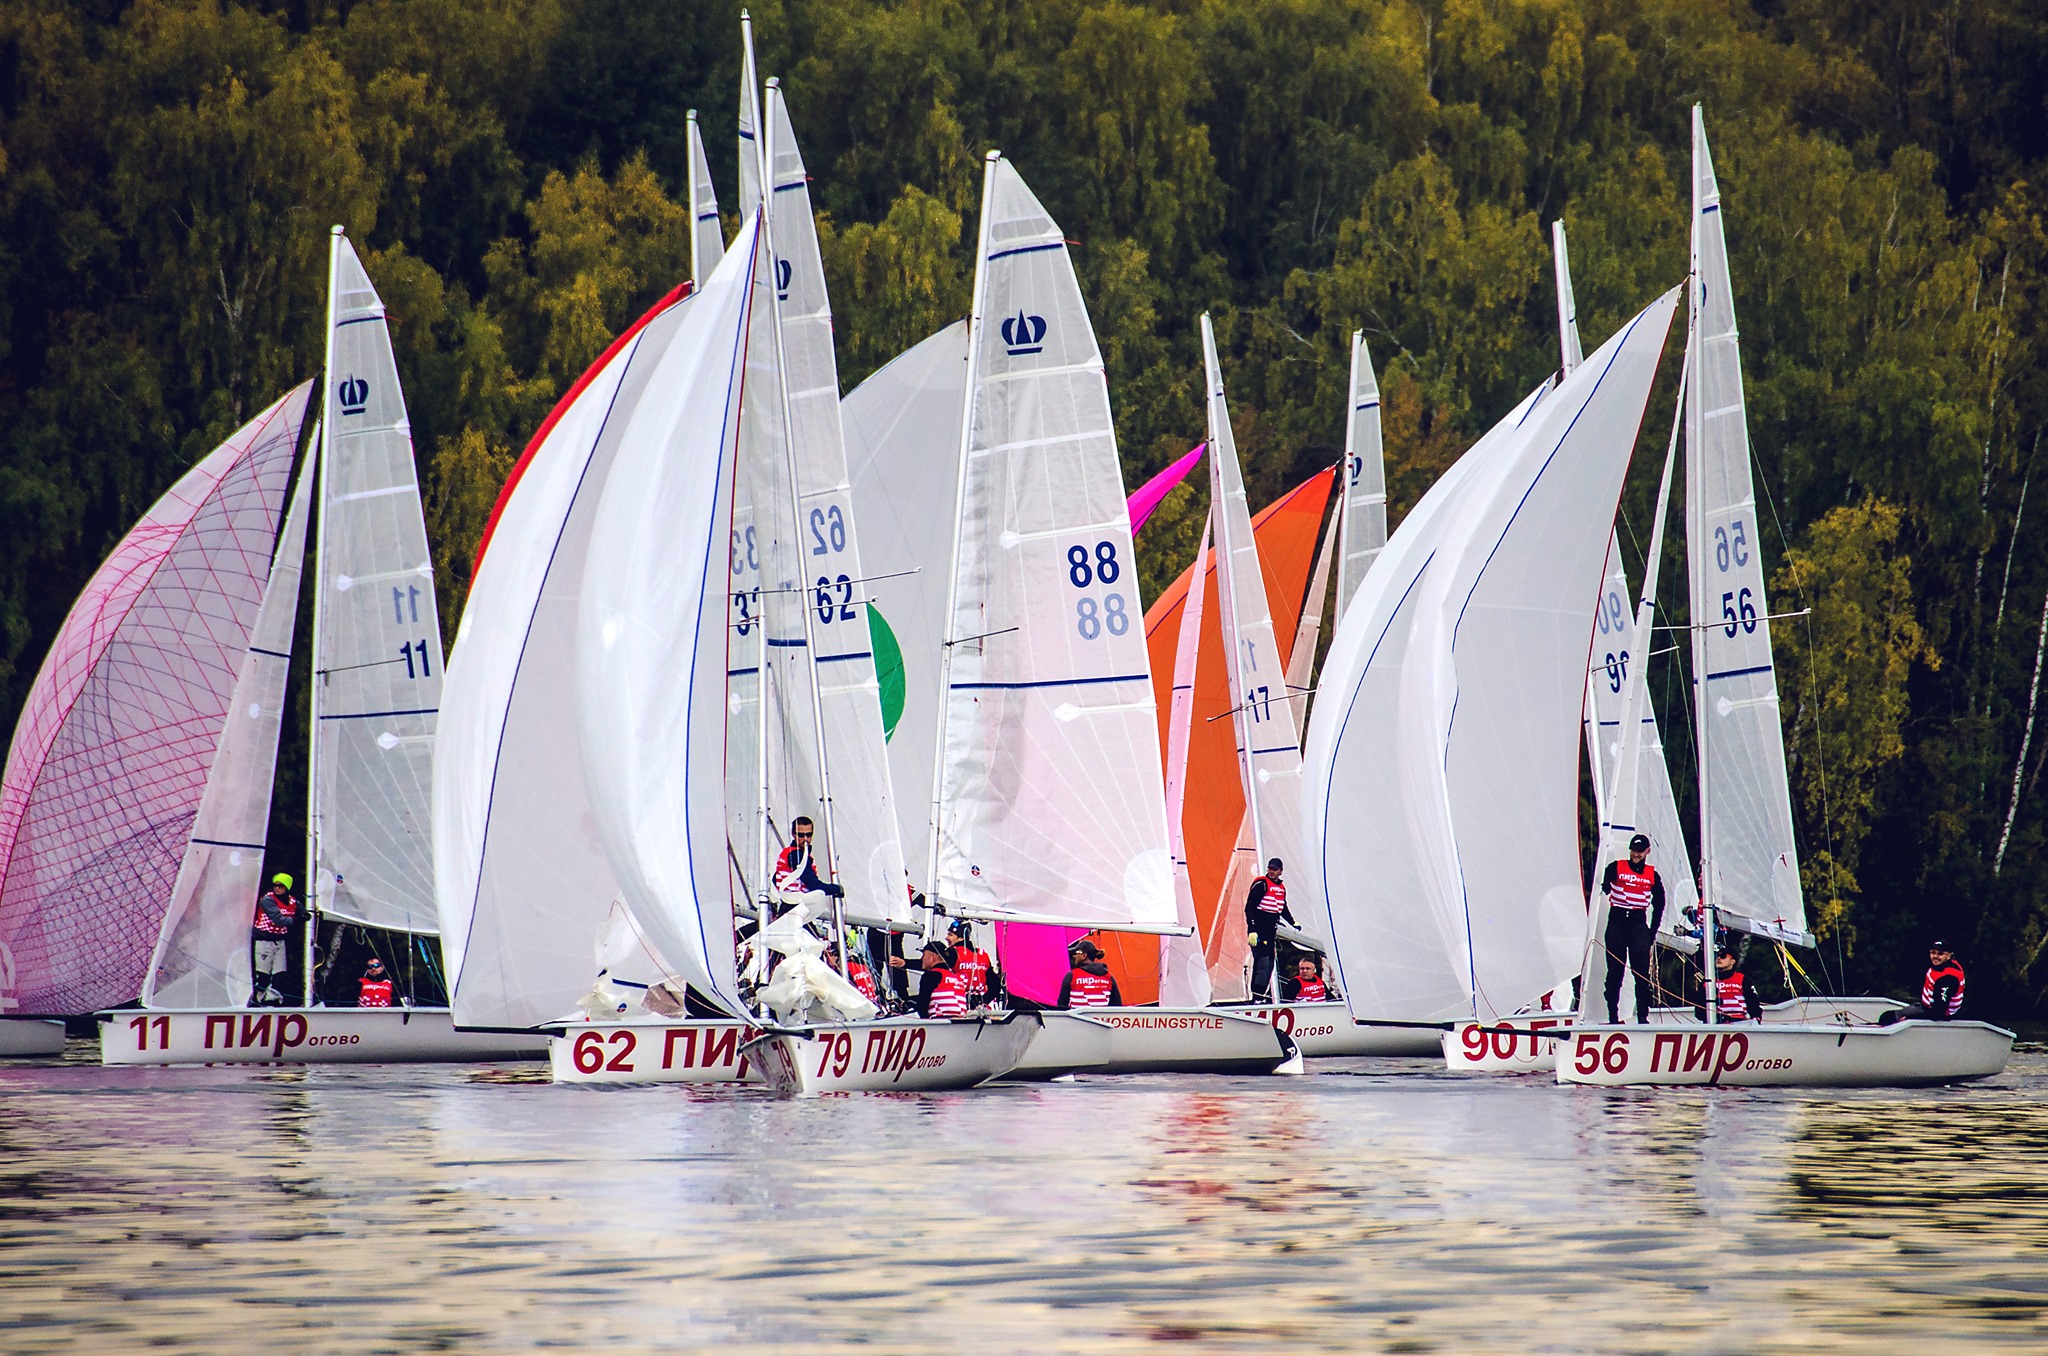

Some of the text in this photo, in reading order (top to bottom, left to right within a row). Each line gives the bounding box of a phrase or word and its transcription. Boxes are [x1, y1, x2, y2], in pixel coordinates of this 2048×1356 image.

[1067, 541, 1120, 588] 88
[816, 574, 857, 625] 62
[1721, 587, 1757, 639] 56
[399, 639, 431, 680] 11
[1248, 685, 1271, 724] 17
[129, 1015, 170, 1051] 11
[573, 1030, 637, 1075] 62
[816, 1032, 853, 1078] 79
[1462, 1022, 1518, 1062] 90
[1574, 1032, 1631, 1075] 56
